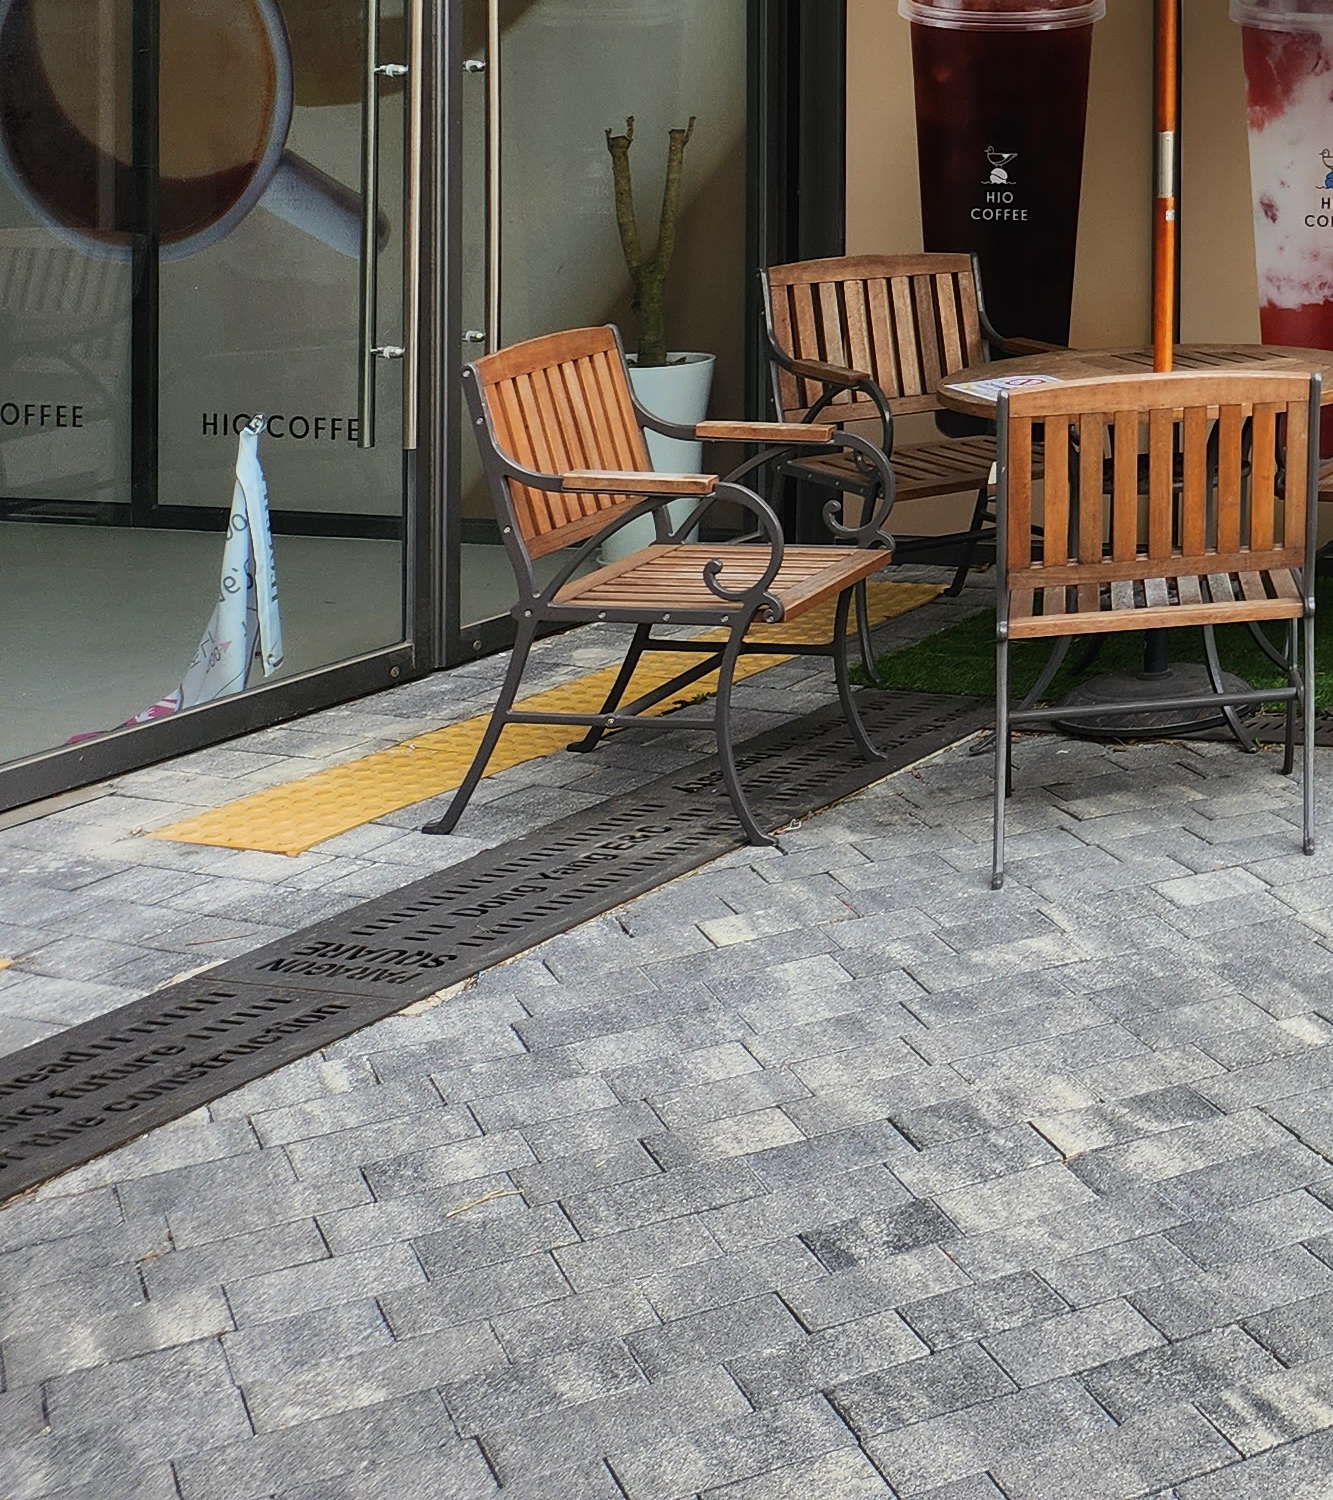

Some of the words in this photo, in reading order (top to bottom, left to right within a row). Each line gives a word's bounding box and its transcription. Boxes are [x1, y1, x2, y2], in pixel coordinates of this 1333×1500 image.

[985, 191, 1014, 205] HIO
[970, 208, 1029, 223] COFFEE
[266, 414, 361, 442] COFFE
[447, 883, 549, 920] Dong
[535, 851, 619, 883] Yang
[598, 823, 673, 851] E&C
[293, 940, 459, 970] SQUARE
[48, 1043, 186, 1100] future
[103, 1003, 352, 1114] construction
